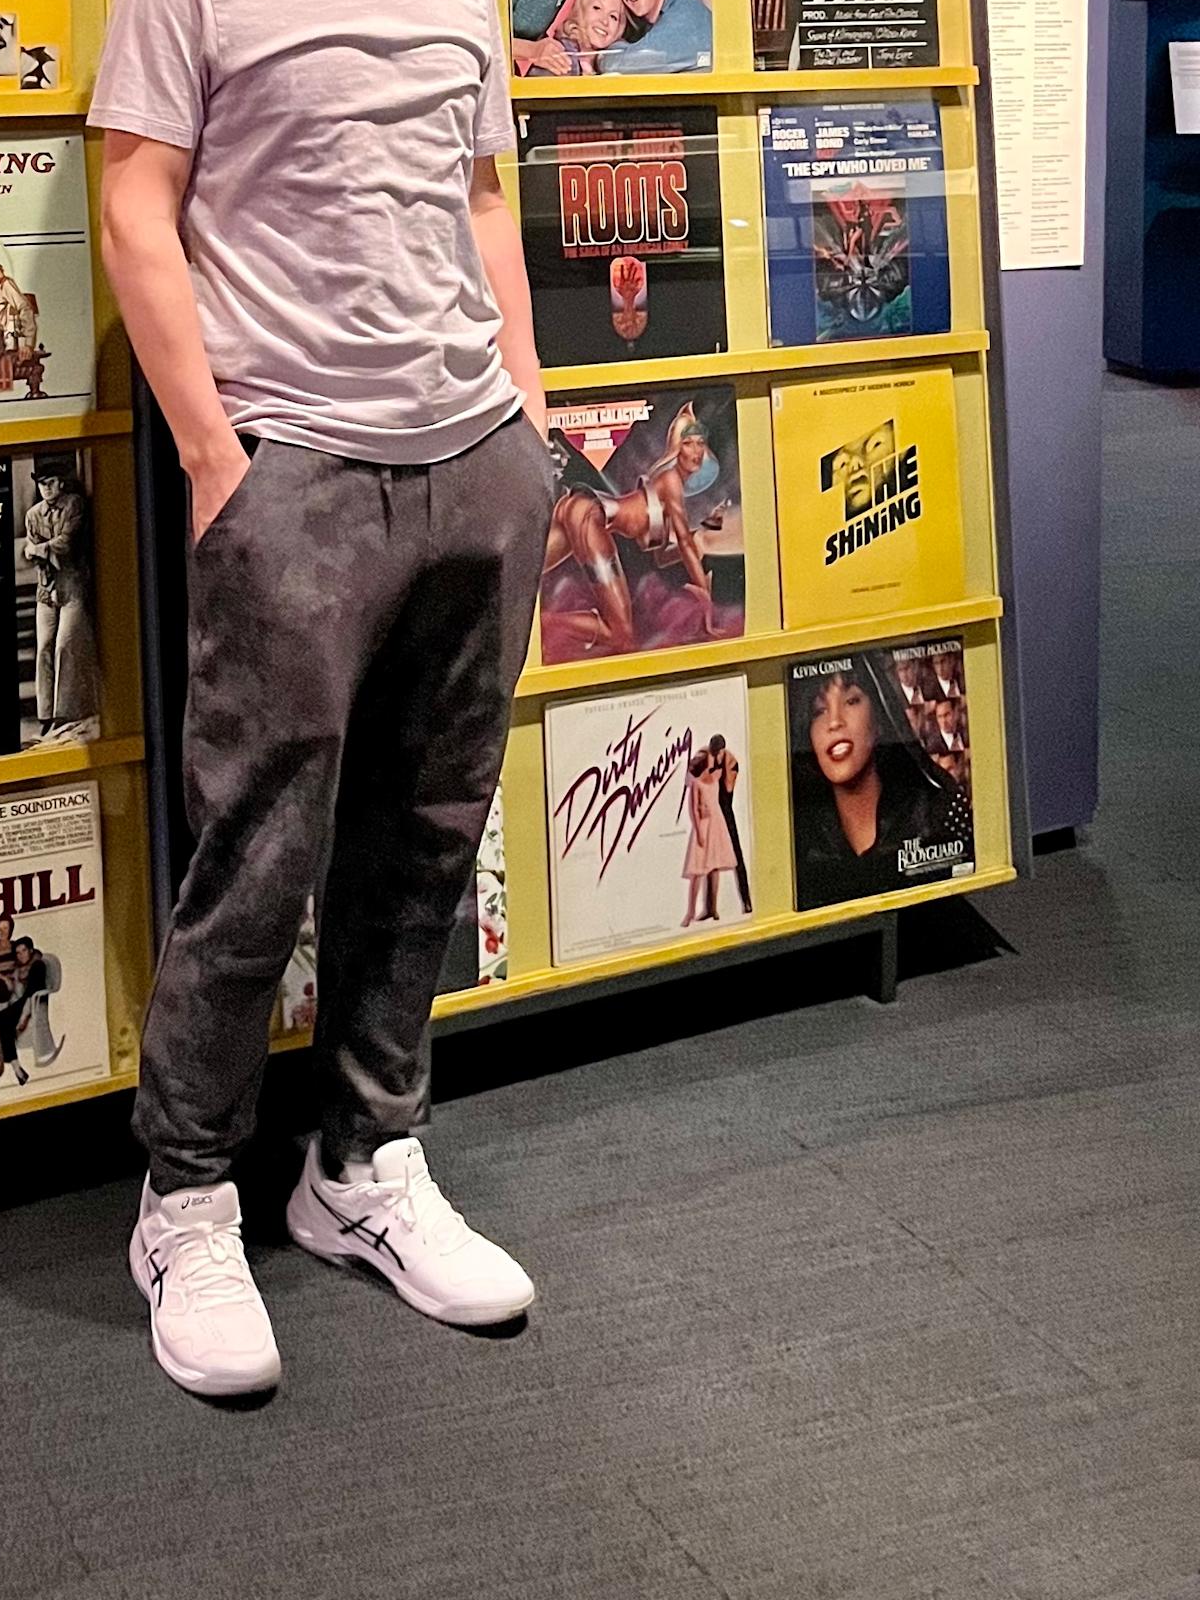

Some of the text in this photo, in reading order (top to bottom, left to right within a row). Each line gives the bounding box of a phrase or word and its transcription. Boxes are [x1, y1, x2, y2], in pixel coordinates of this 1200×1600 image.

[812, 161, 836, 176] SPY
[837, 160, 870, 174] WHO
[870, 159, 906, 173] LOVED
[558, 161, 688, 247] ROOTS
[820, 418, 919, 523] THE
[893, 641, 961, 662] WHITNEY HOUSTON
[793, 658, 852, 680] KEVIN COSTNER
[554, 704, 664, 860] Dirty
[10, 792, 91, 817] SOUNDTRACK
[587, 726, 692, 885] Dancing
[898, 840, 964, 872] BODYGUARD
[903, 836, 920, 850] THE
